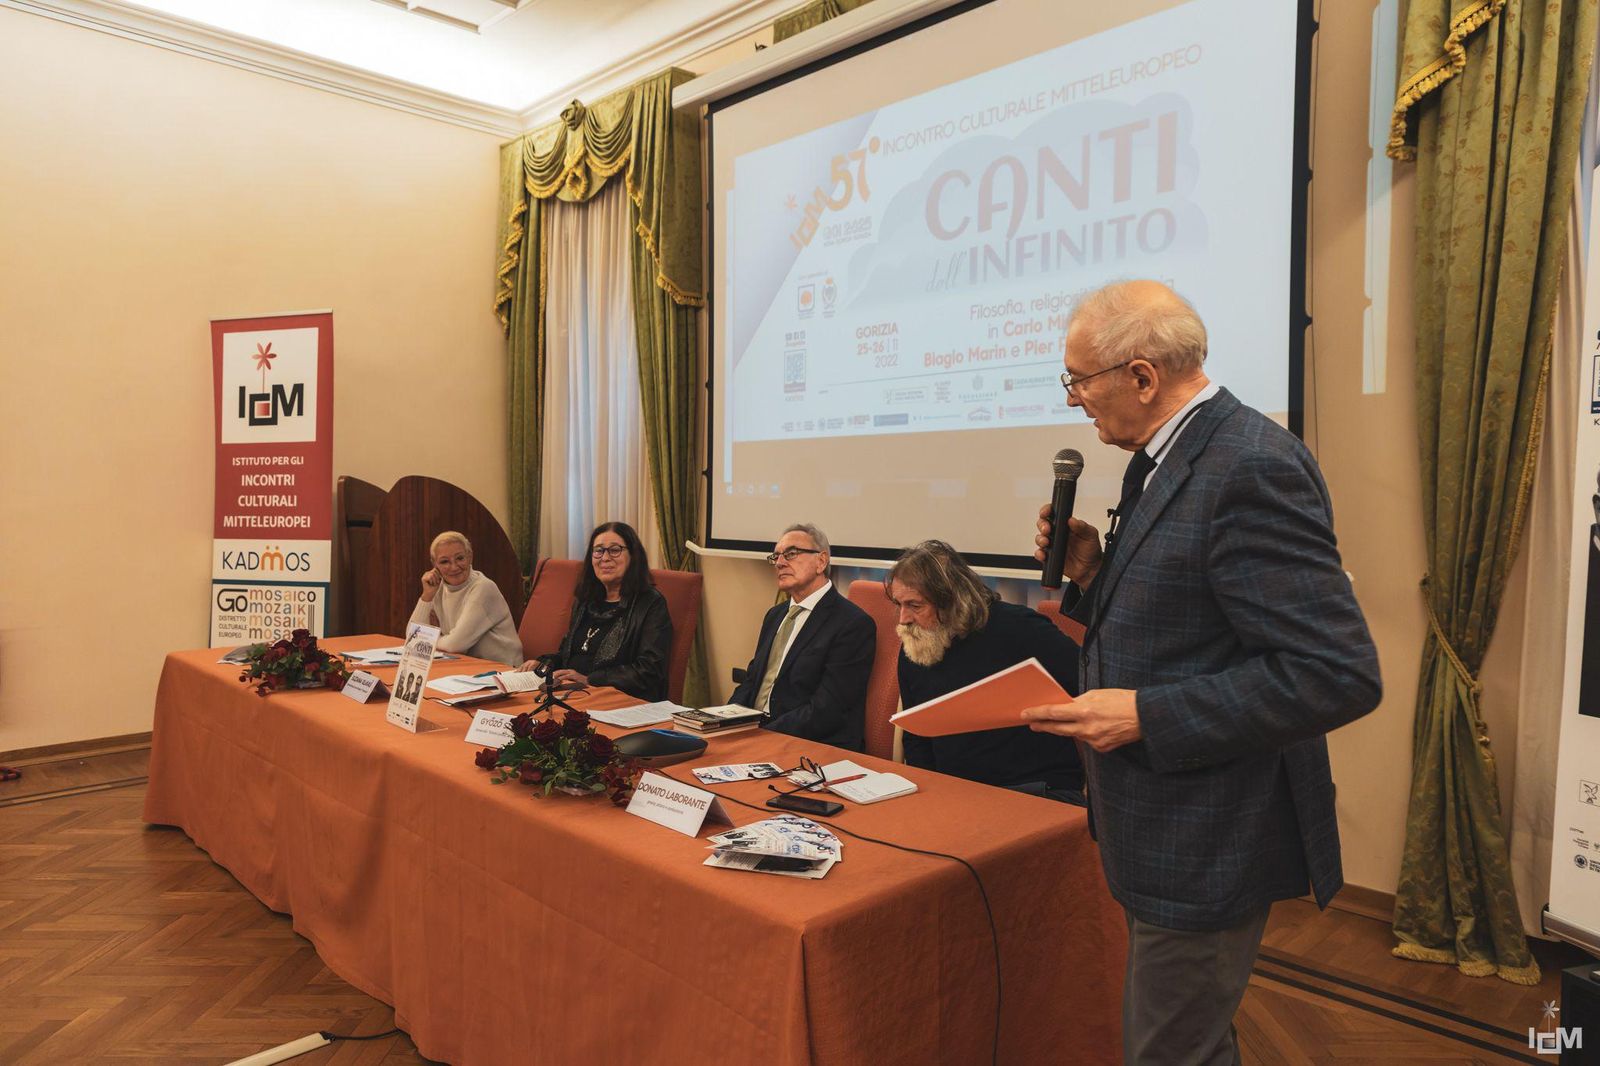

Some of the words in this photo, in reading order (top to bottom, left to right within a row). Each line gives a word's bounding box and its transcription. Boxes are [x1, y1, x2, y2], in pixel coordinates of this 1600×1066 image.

[881, 120, 956, 157] INCONTRO
[958, 91, 1047, 132] CULTURALE
[1050, 43, 1203, 106] MITTELEUROPEO
[925, 110, 1179, 241] CANTI
[970, 299, 1026, 321] Filosofia,
[856, 322, 899, 340] GORIZIA
[988, 323, 999, 339] in
[1003, 317, 1043, 337] Carlo
[875, 354, 899, 368] 2022
[924, 349, 964, 369] Biagio
[968, 343, 1006, 362] Marin
[1010, 345, 1021, 358] e
[1025, 339, 1055, 356] Pier
[232, 457, 271, 466] ISTITUTO
[272, 456, 289, 465] PER
[290, 456, 304, 465] GLI
[241, 474, 295, 486] INCONTRI
[238, 495, 297, 507] CULTURALI
[223, 516, 311, 528] MITTELEUROPEI
[249, 589, 316, 603] mosaico
[248, 627, 291, 641] mosa
[637, 782, 666, 798] DONATO
[666, 790, 707, 810] LABORANTE
